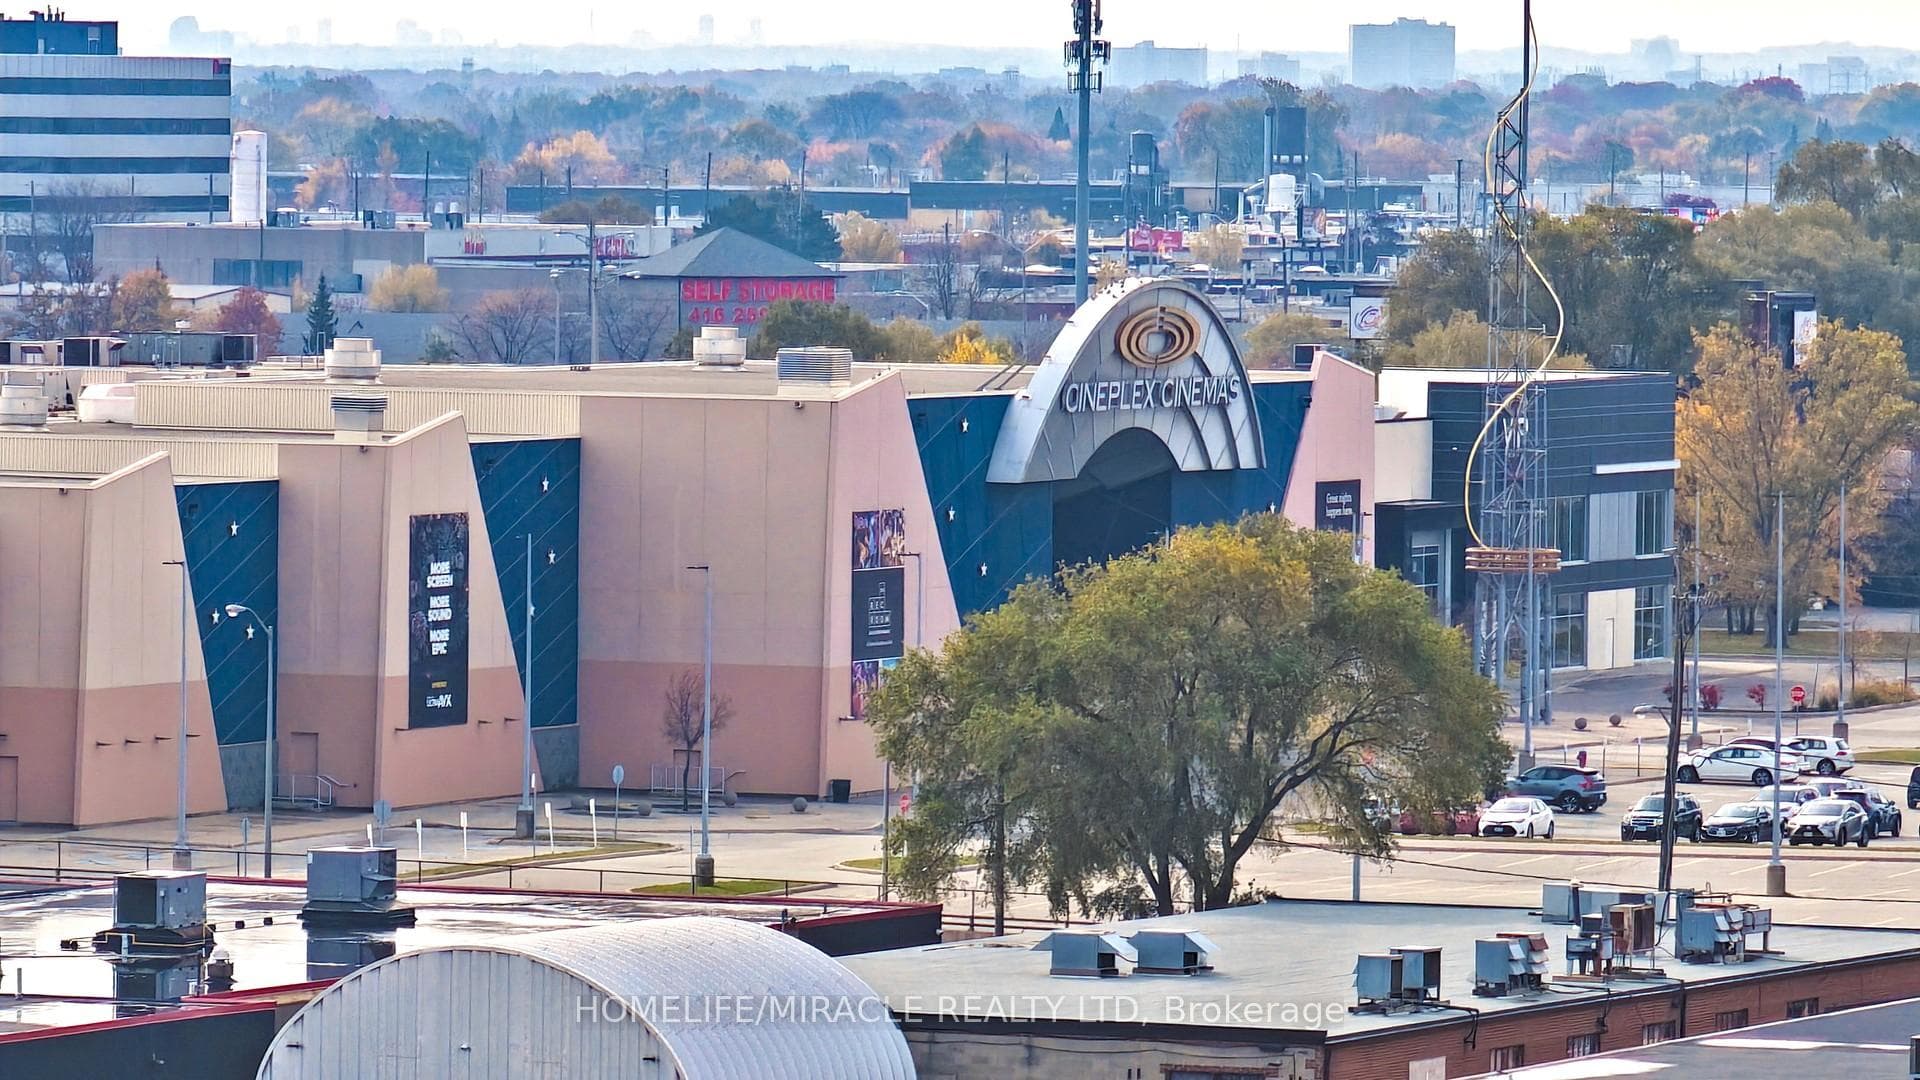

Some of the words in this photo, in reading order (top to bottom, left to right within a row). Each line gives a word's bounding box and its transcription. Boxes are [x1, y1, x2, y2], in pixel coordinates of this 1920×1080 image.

[682, 279, 731, 302] SELF
[739, 278, 835, 303] STORAGE
[688, 306, 724, 323] 416
[1065, 379, 1155, 413] CINEPLEX
[1161, 376, 1241, 408] CINEMAS
[430, 561, 450, 575] MORE
[426, 574, 453, 588] SCREEN
[429, 595, 450, 609] MORE
[428, 608, 452, 622] SOUND
[429, 629, 450, 642] MORE
[431, 642, 447, 655] EPIC
